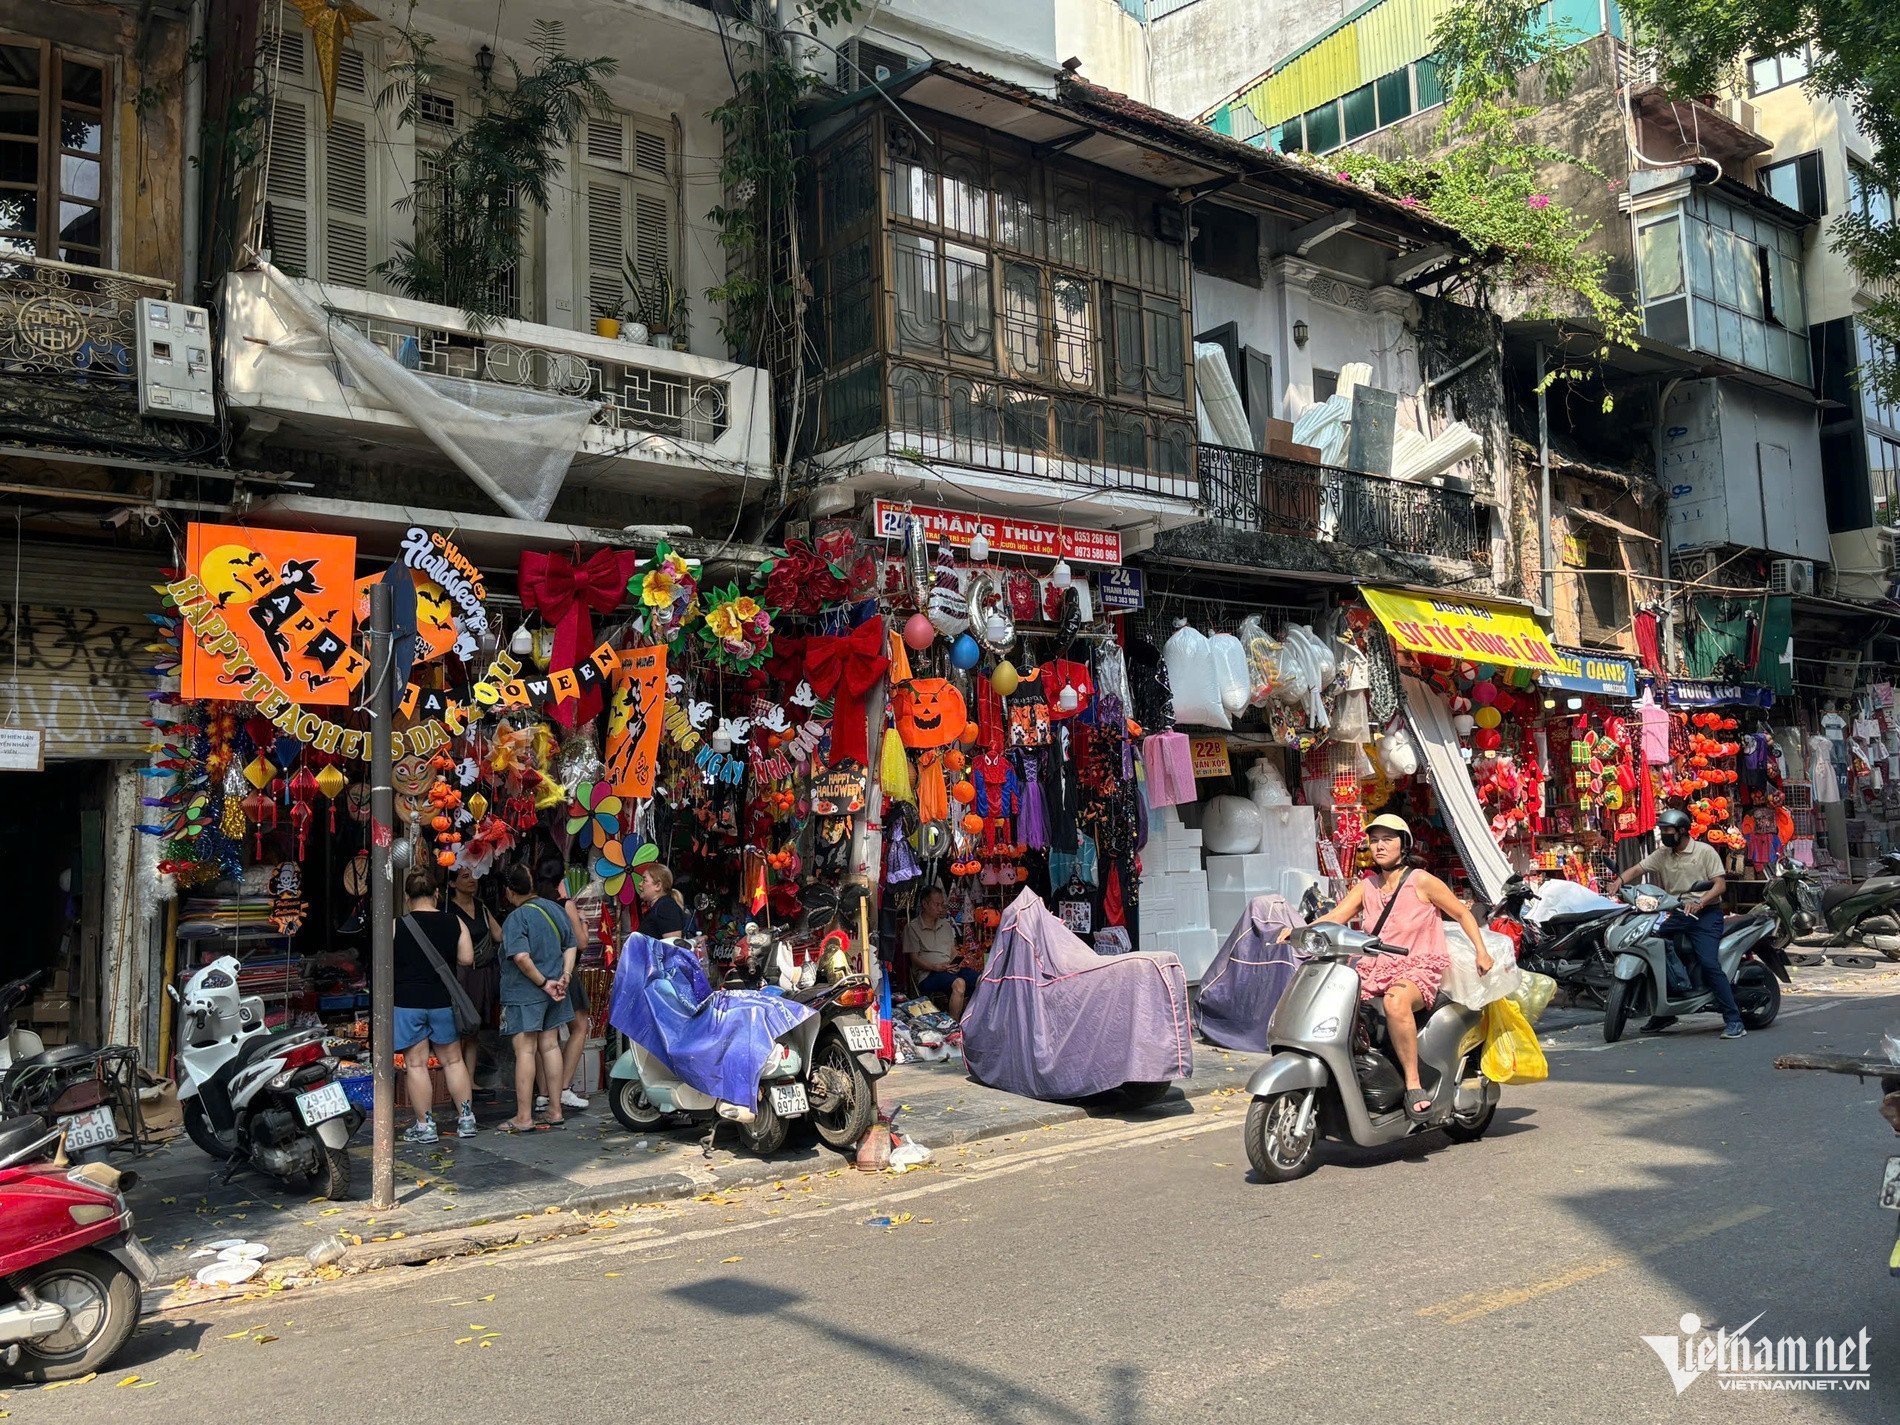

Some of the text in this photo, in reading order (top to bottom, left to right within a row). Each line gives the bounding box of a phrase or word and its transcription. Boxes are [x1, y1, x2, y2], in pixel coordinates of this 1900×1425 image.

[919, 515, 995, 537] THẮNG
[1002, 525, 1055, 544] THỦY
[1074, 531, 1117, 546] 0353 268 966
[443, 541, 484, 584] HAPPY
[1074, 547, 1117, 561] 0973 580 966
[400, 527, 487, 619] Halloween
[1110, 569, 1131, 586] 24
[1103, 585, 1123, 595] THANH
[167, 574, 255, 674] HAPPY
[254, 566, 362, 674] HAPPY
[1392, 618, 1559, 666] SƯ TỬ RỒNG LÂN
[1195, 741, 1221, 758] 22B
[694, 744, 745, 785] NGÀY
[752, 748, 793, 785] NHÀ
[828, 773, 851, 785] HAPPY
[816, 784, 863, 798] HALLOWEEN
[849, 1025, 876, 1037] 89-F1
[304, 1086, 339, 1110] 29-D1
[776, 1085, 801, 1100] 29-AG
[777, 1098, 807, 1114] 897.23
[66, 1124, 114, 1148] 569.66
